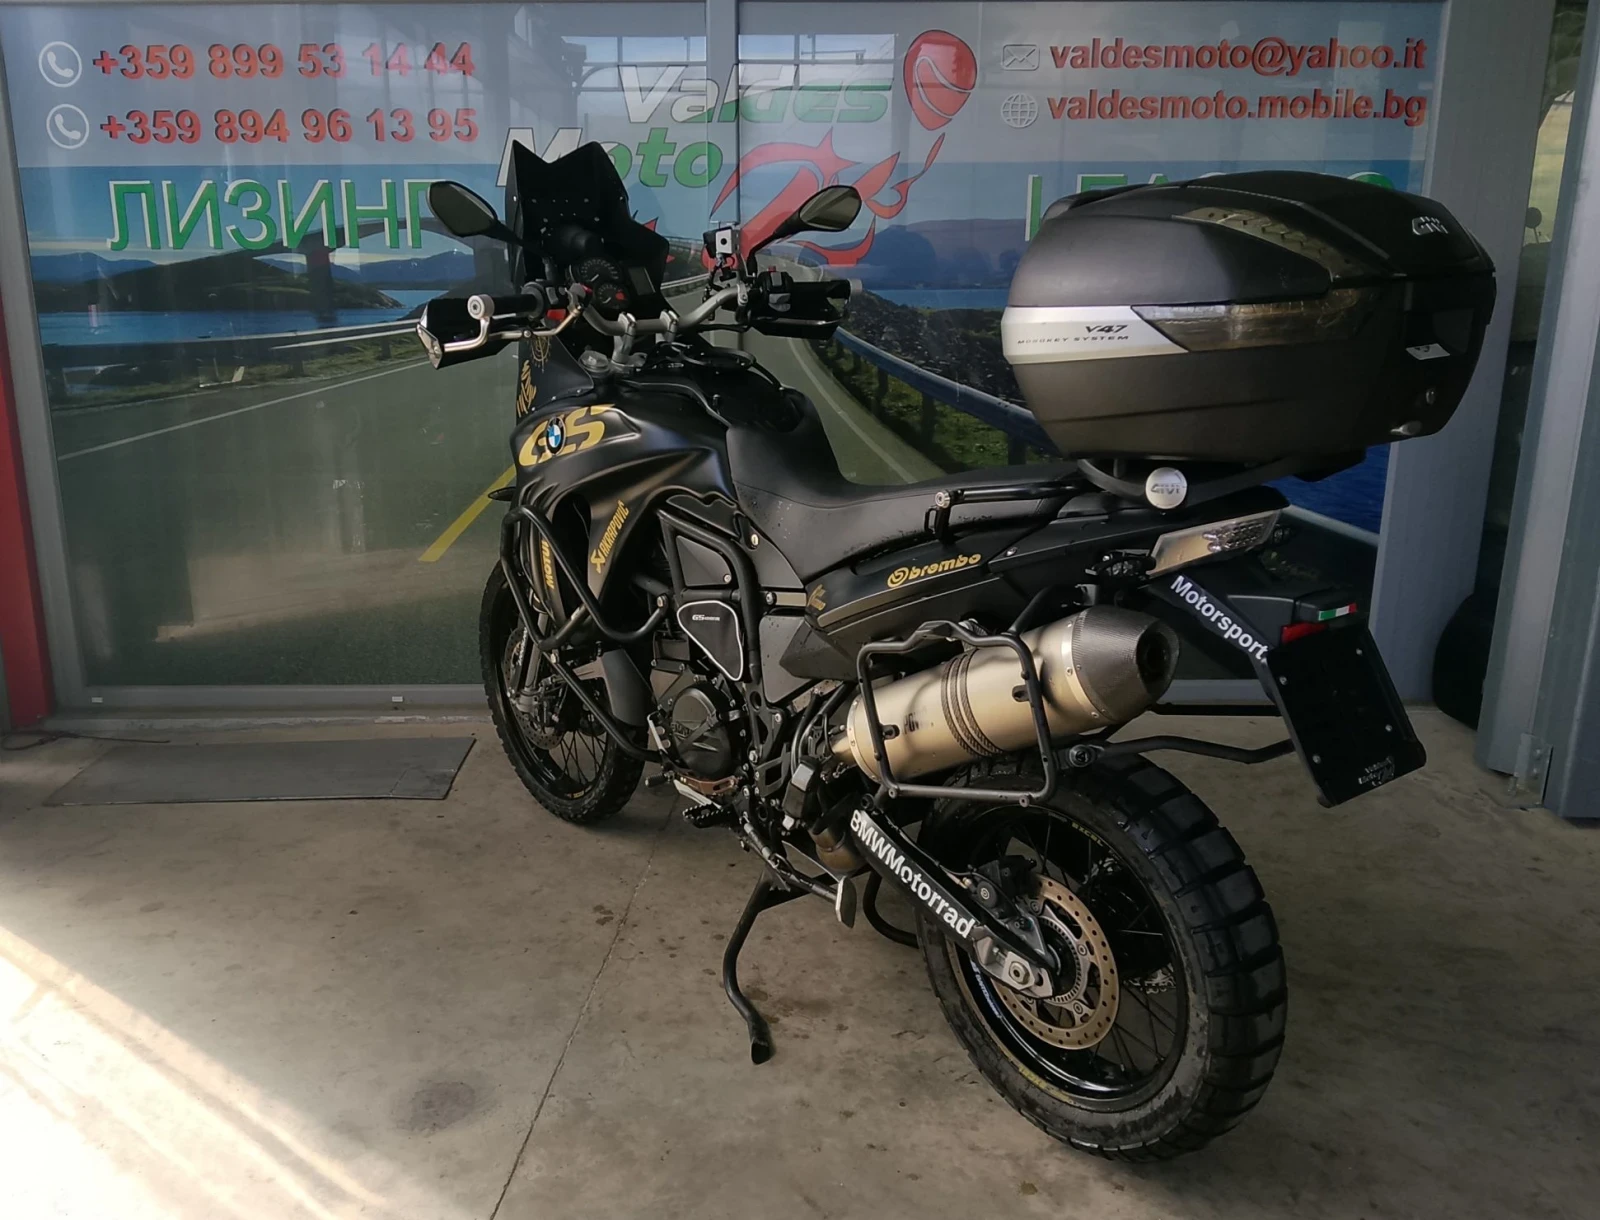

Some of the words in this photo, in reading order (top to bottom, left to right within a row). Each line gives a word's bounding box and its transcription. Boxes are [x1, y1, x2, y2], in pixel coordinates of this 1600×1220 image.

[92, 44, 195, 80] +359
[208, 43, 285, 79] 899
[297, 43, 347, 79] 53
[362, 42, 412, 77] 14
[424, 41, 476, 77] 44
[1050, 37, 1427, 76] valdesmoto@yahoo.it
[618, 64, 895, 123] Valdes
[1047, 88, 1427, 127] valdesmoto.mobile.bg
[100, 109, 202, 145] +359
[214, 108, 290, 144] 894
[301, 108, 353, 144] 96
[366, 107, 416, 143] 13
[427, 107, 479, 143] 95
[106, 179, 446, 250] ЛИЗИНГ
[1085, 324, 1128, 334] V47
[518, 404, 615, 467] GS
[908, 553, 982, 581] brembo
[1170, 575, 1268, 660] Motorsport
